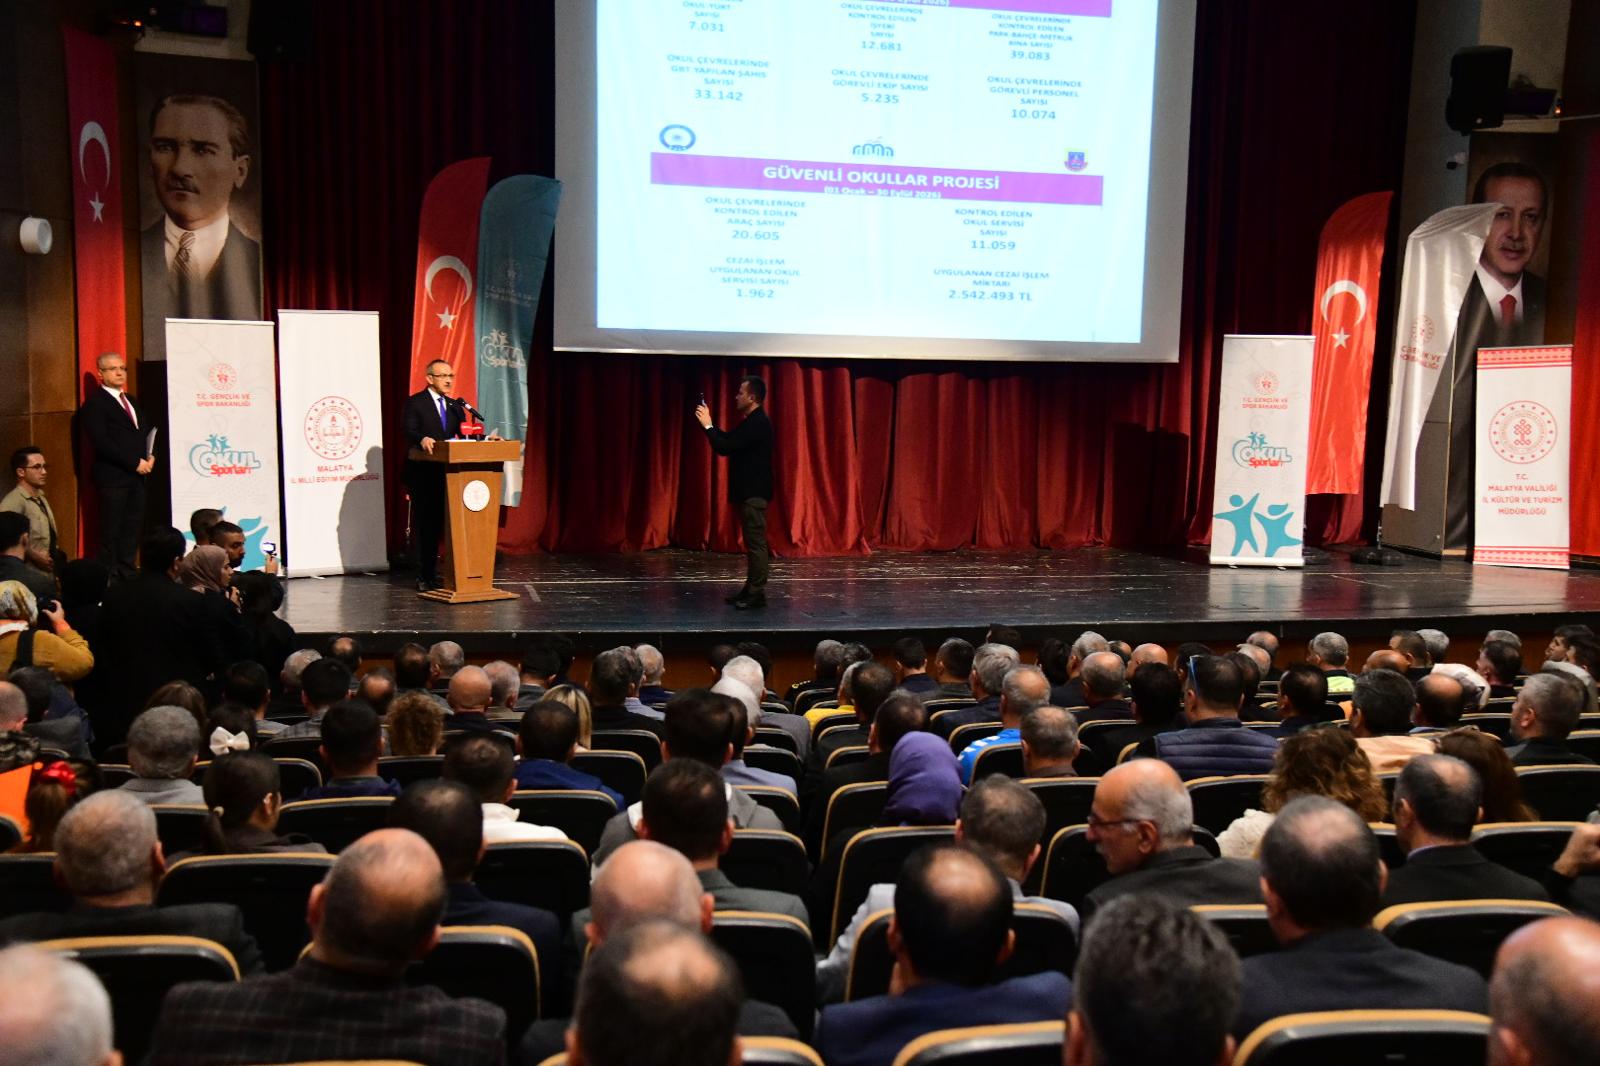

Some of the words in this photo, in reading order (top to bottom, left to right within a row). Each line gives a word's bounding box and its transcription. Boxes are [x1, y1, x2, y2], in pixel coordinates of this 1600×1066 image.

[689, 20, 725, 32] 7.031
[861, 40, 902, 51] 12.681
[1011, 49, 1050, 61] 39.083
[695, 89, 743, 101] 33.142
[861, 93, 900, 104] 5.235
[1011, 109, 1057, 120] 10.074
[763, 164, 843, 182] GÜVENLİ
[847, 171, 928, 186] OKULLAR
[932, 175, 1000, 190] PROJESİ
[731, 230, 780, 241] 20.605
[971, 240, 1017, 251] 11.059
[736, 288, 775, 299] 1.962
[949, 289, 1015, 301] 2.542.493
[1019, 292, 1033, 302] TL
[317, 464, 354, 473] MALATYA
[1487, 484, 1523, 492] MALATYA
[1491, 496, 1521, 504] KÜLTÜR
[1498, 506, 1547, 515] MÜDÜRLÜĞÜ
